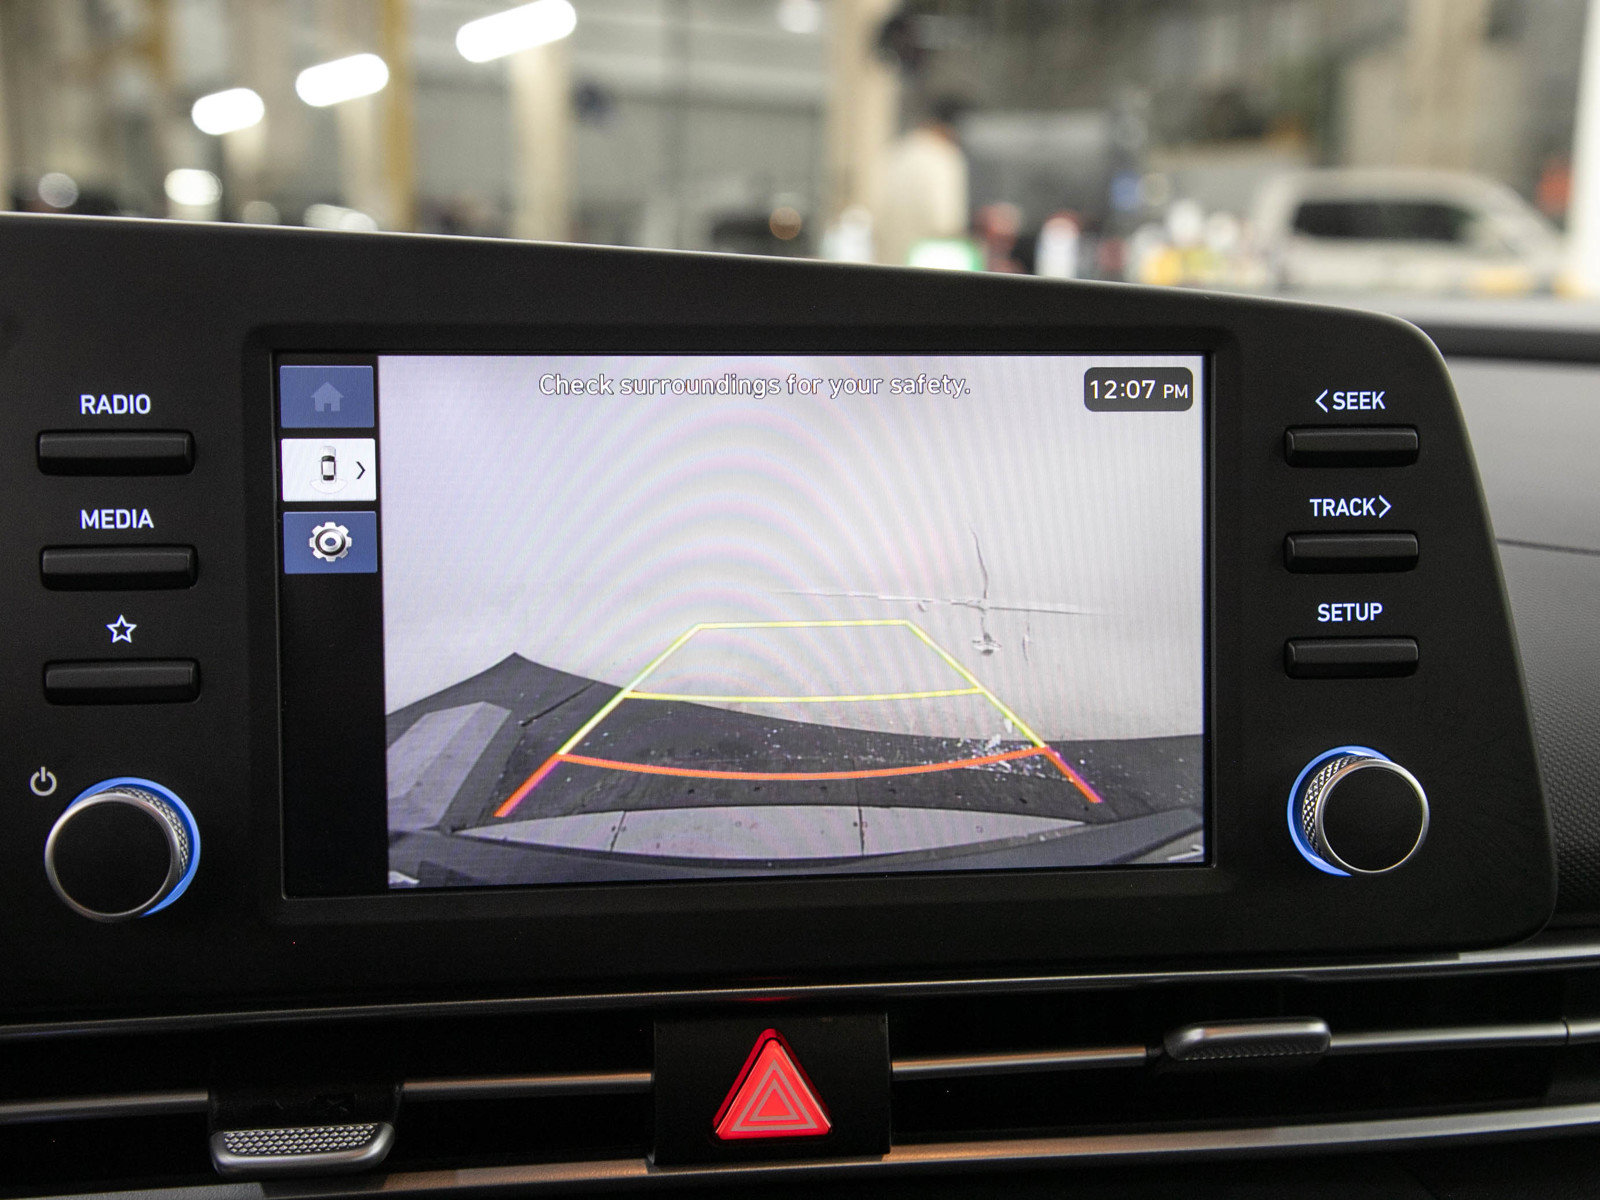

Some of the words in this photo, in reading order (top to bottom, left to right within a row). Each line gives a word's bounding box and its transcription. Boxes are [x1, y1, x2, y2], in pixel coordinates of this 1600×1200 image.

[538, 373, 614, 395] Check
[619, 373, 781, 399] surroundings
[786, 373, 823, 395] for
[828, 378, 884, 399] your
[890, 373, 971, 399] safety.
[1090, 380, 1156, 400] 12:07
[1163, 383, 1189, 399] PM
[80, 393, 152, 415] RADIO
[80, 508, 155, 530] MEDIA
[1317, 602, 1383, 623] SETUP
